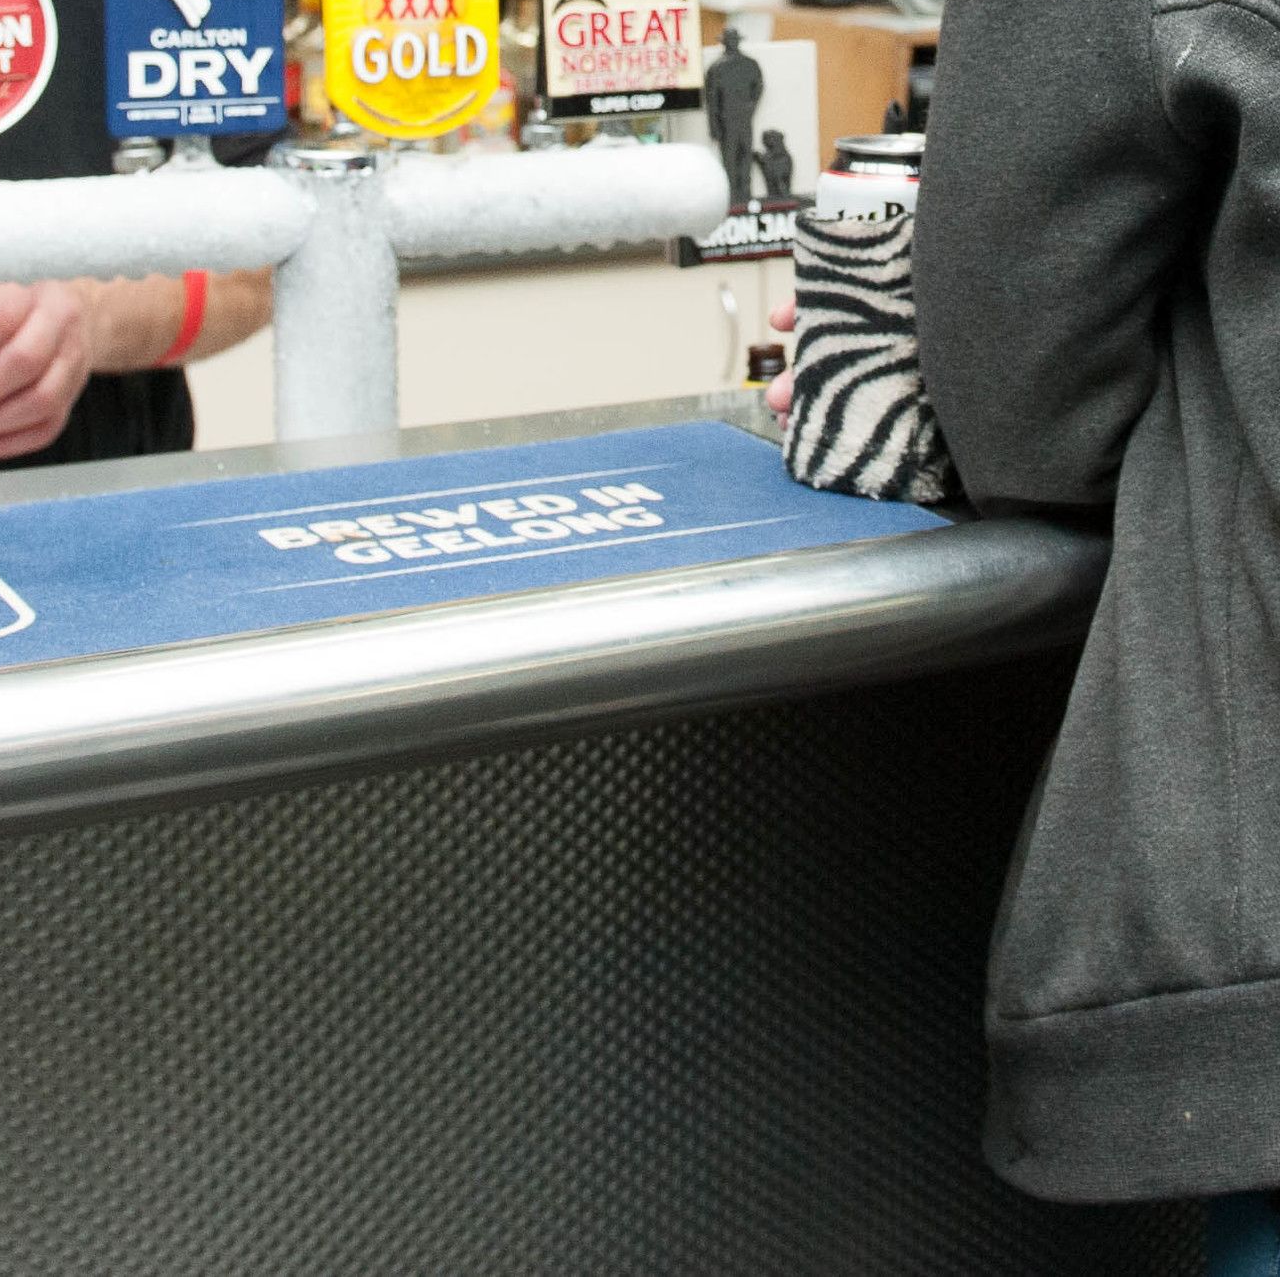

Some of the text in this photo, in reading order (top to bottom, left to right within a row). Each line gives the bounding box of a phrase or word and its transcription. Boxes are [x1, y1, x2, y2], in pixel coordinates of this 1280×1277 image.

[150, 28, 247, 48] CARLTON
[351, 24, 488, 85] GOLD
[557, 8, 688, 49] GREAT
[128, 47, 274, 99] DRY
[561, 48, 689, 75] NORTHERN
[258, 482, 665, 550] BREWED IN
[334, 504, 665, 565] GEELONG
